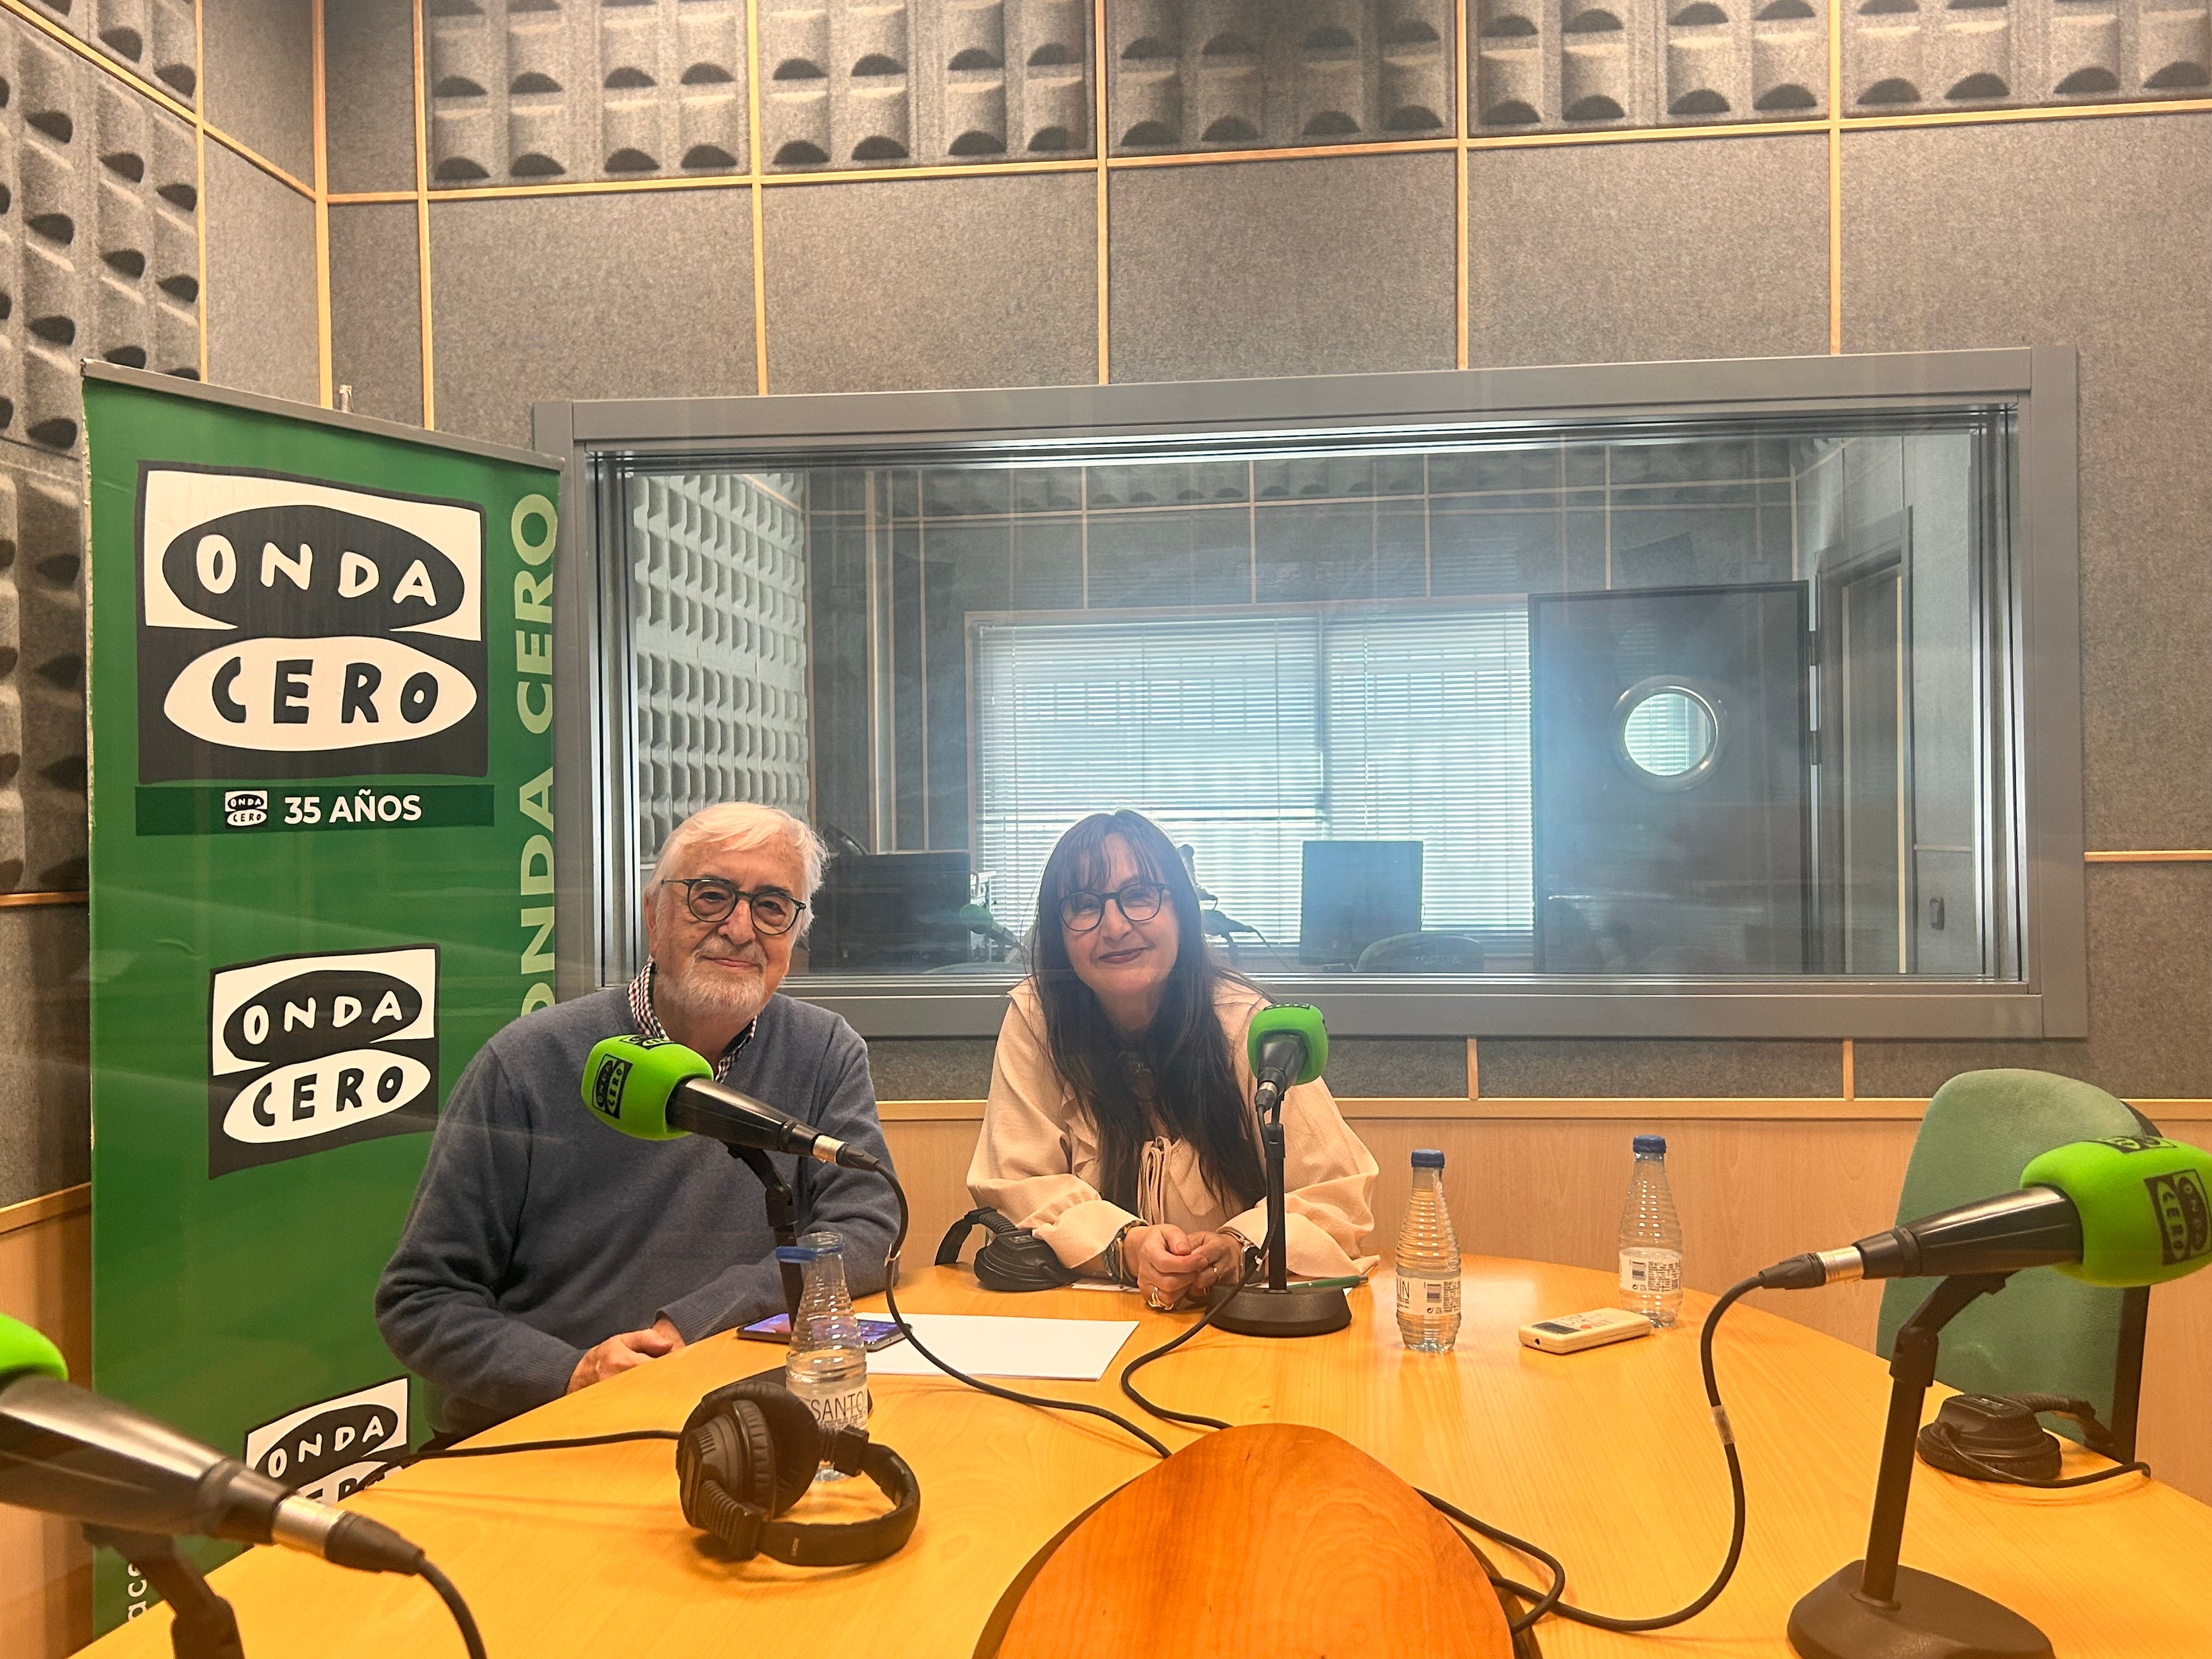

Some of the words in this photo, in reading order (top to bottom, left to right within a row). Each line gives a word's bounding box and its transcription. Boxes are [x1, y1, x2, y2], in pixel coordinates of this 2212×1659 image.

[196, 534, 437, 606] ONDA
[511, 493, 558, 734] CERO
[212, 656, 438, 724] CERO
[230, 798, 262, 808] ONDA
[233, 813, 262, 822] CERO
[284, 797, 321, 824] 35
[329, 789, 422, 823] AÑOS
[242, 990, 403, 1045] ONDA
[253, 1066, 403, 1127] CERO
[608, 1068, 623, 1107] CERO
[268, 1415, 384, 1478] ONDA
